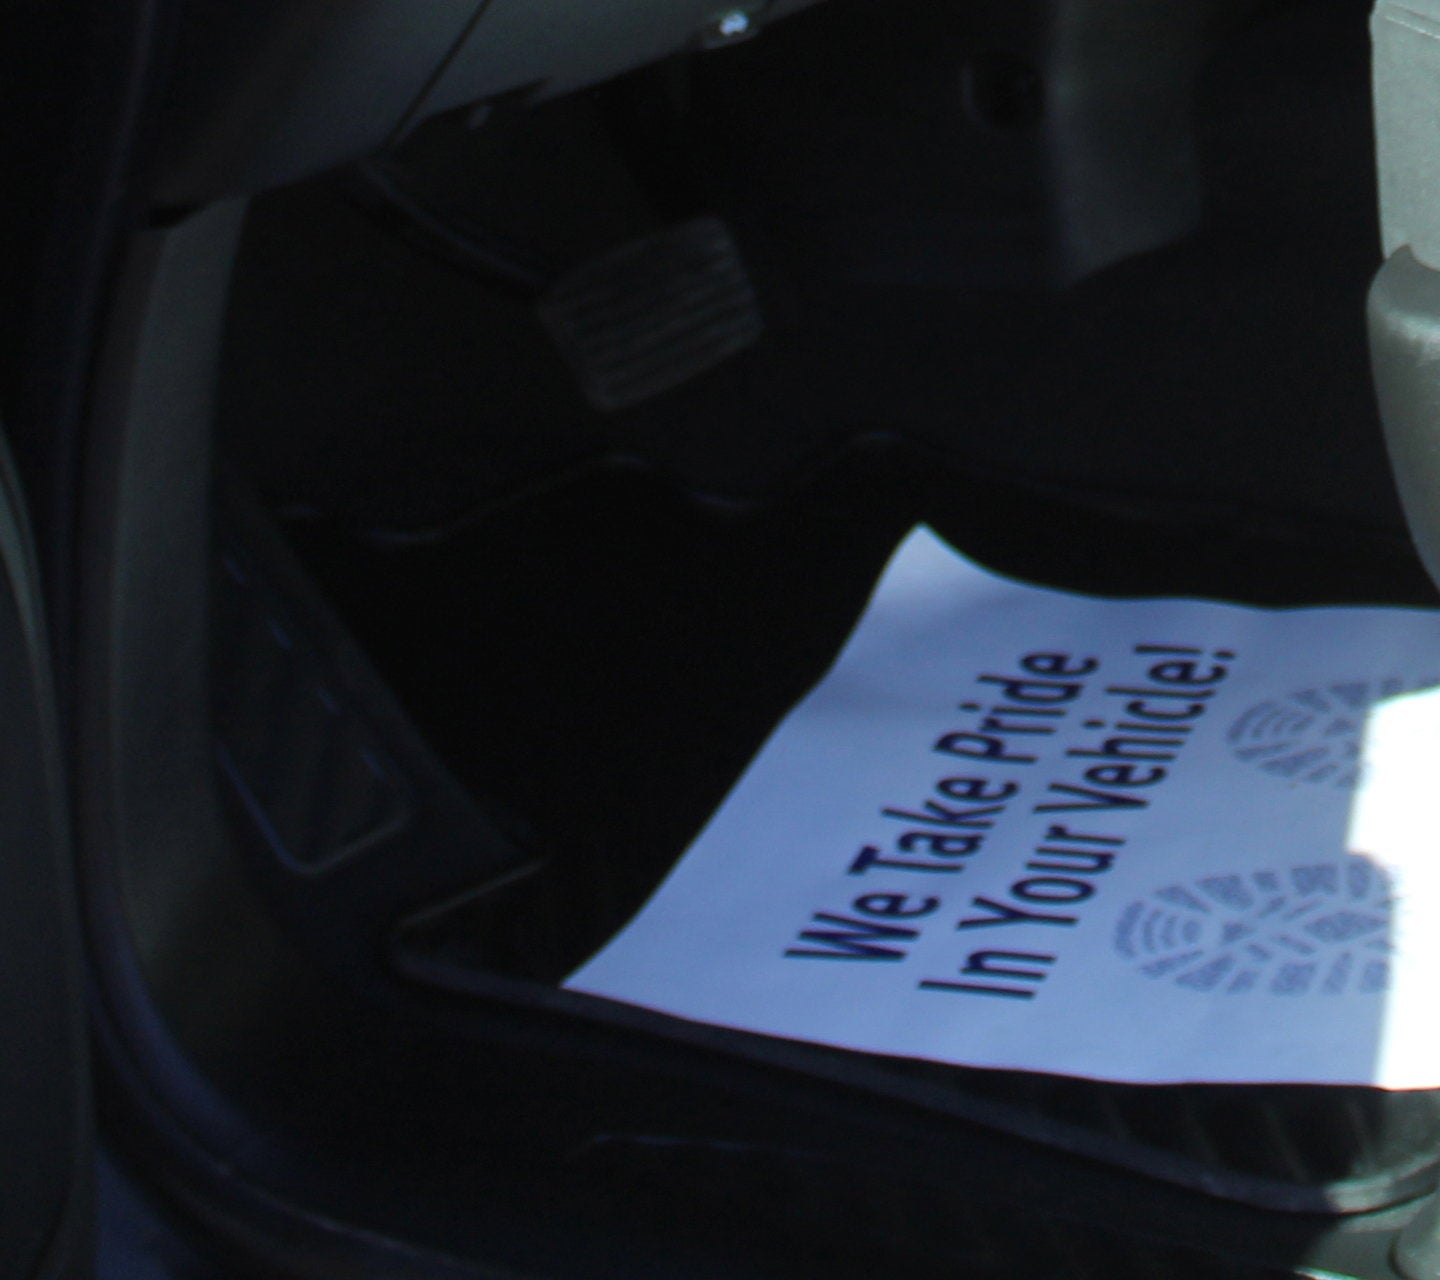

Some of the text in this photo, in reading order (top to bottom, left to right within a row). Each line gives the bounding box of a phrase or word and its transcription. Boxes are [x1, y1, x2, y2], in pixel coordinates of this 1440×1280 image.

[783, 652, 1100, 963] We Take Pride
[917, 644, 1237, 1001] In Your Vehicle!
